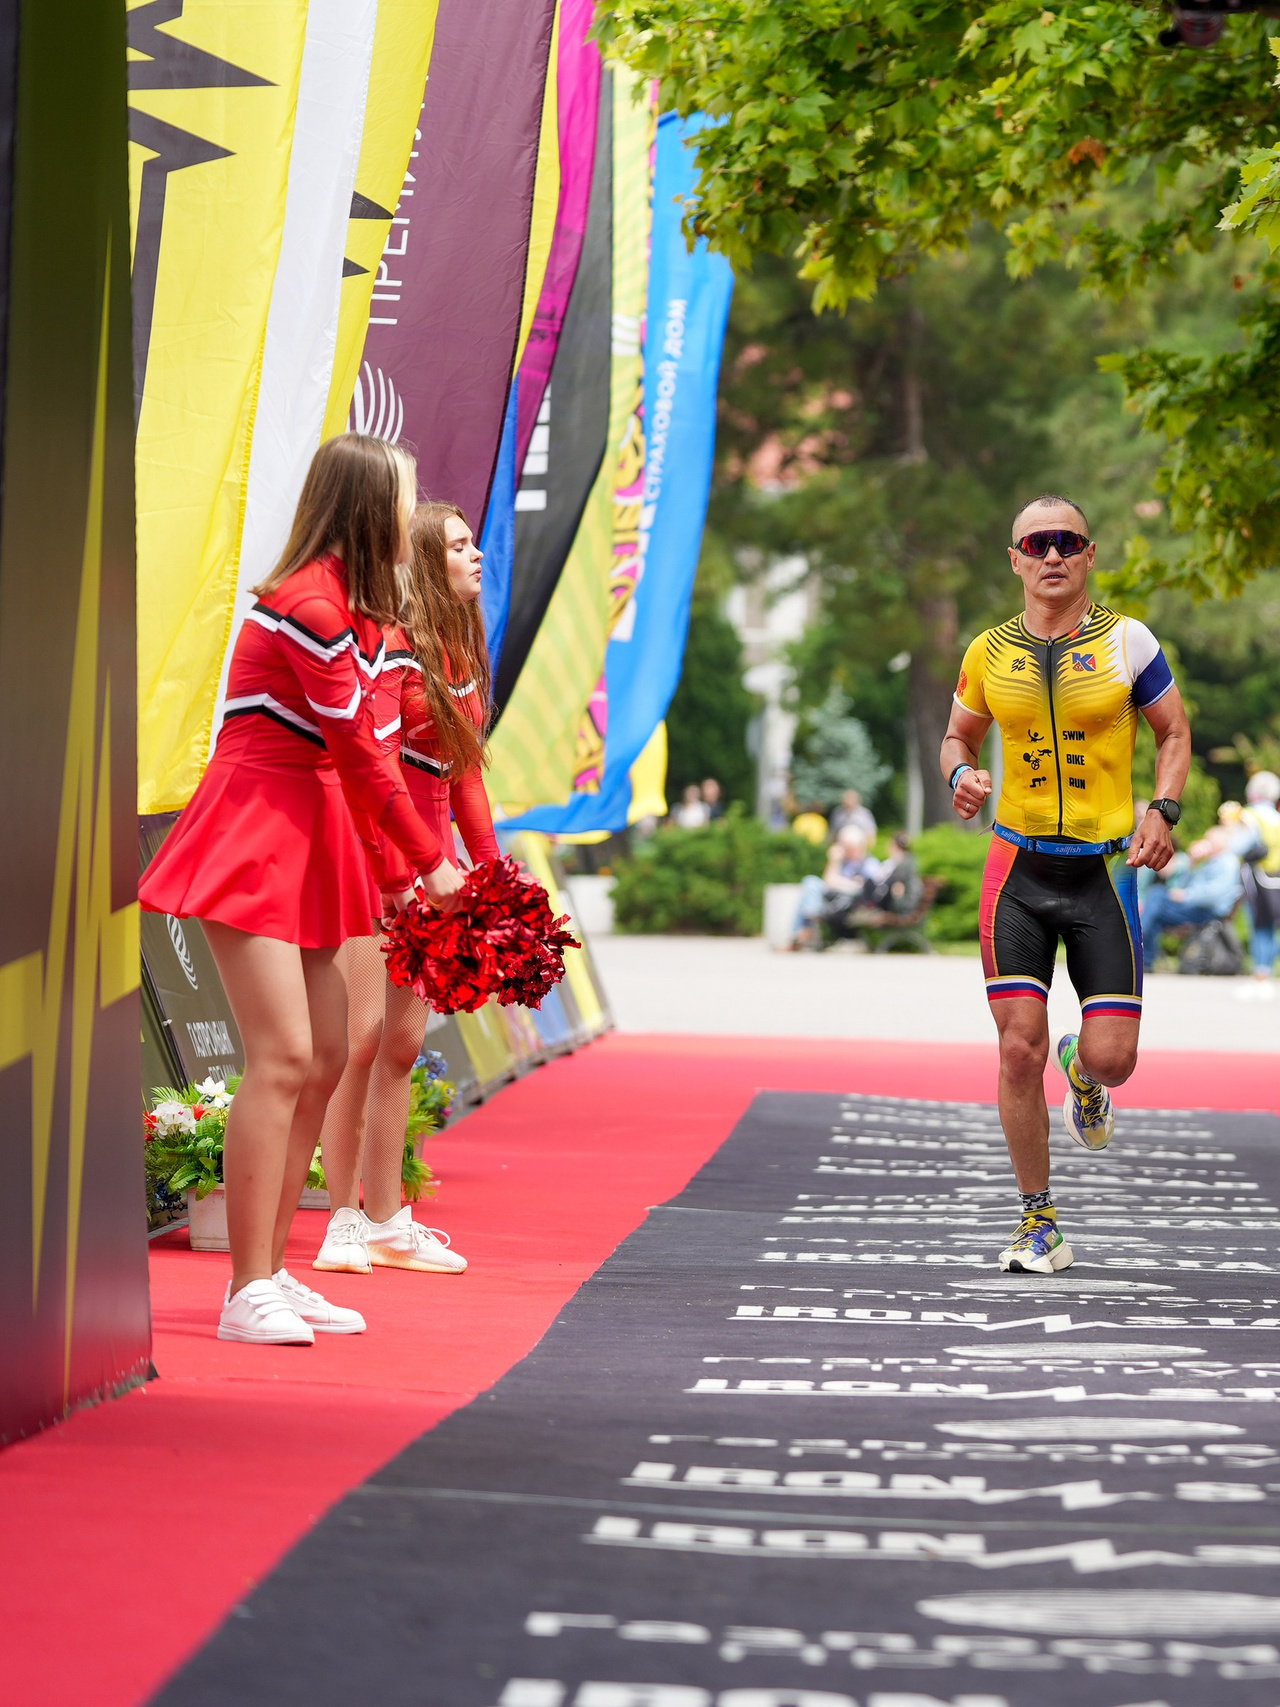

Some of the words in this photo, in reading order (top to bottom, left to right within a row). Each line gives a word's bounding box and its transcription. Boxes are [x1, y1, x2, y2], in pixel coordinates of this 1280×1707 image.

[663, 298, 688, 358] ДОМ
[1062, 730, 1085, 741] SWIM
[1066, 753, 1085, 766] BIKE
[1069, 776, 1086, 790] RUN
[1000, 829, 1021, 844] sailfish
[1054, 846, 1082, 855] sailfish
[762, 1251, 985, 1263] IRON
[735, 1306, 989, 1322] IRON
[692, 1378, 989, 1394] IRON
[632, 1461, 986, 1494] IRON
[591, 1516, 986, 1553] IRON
